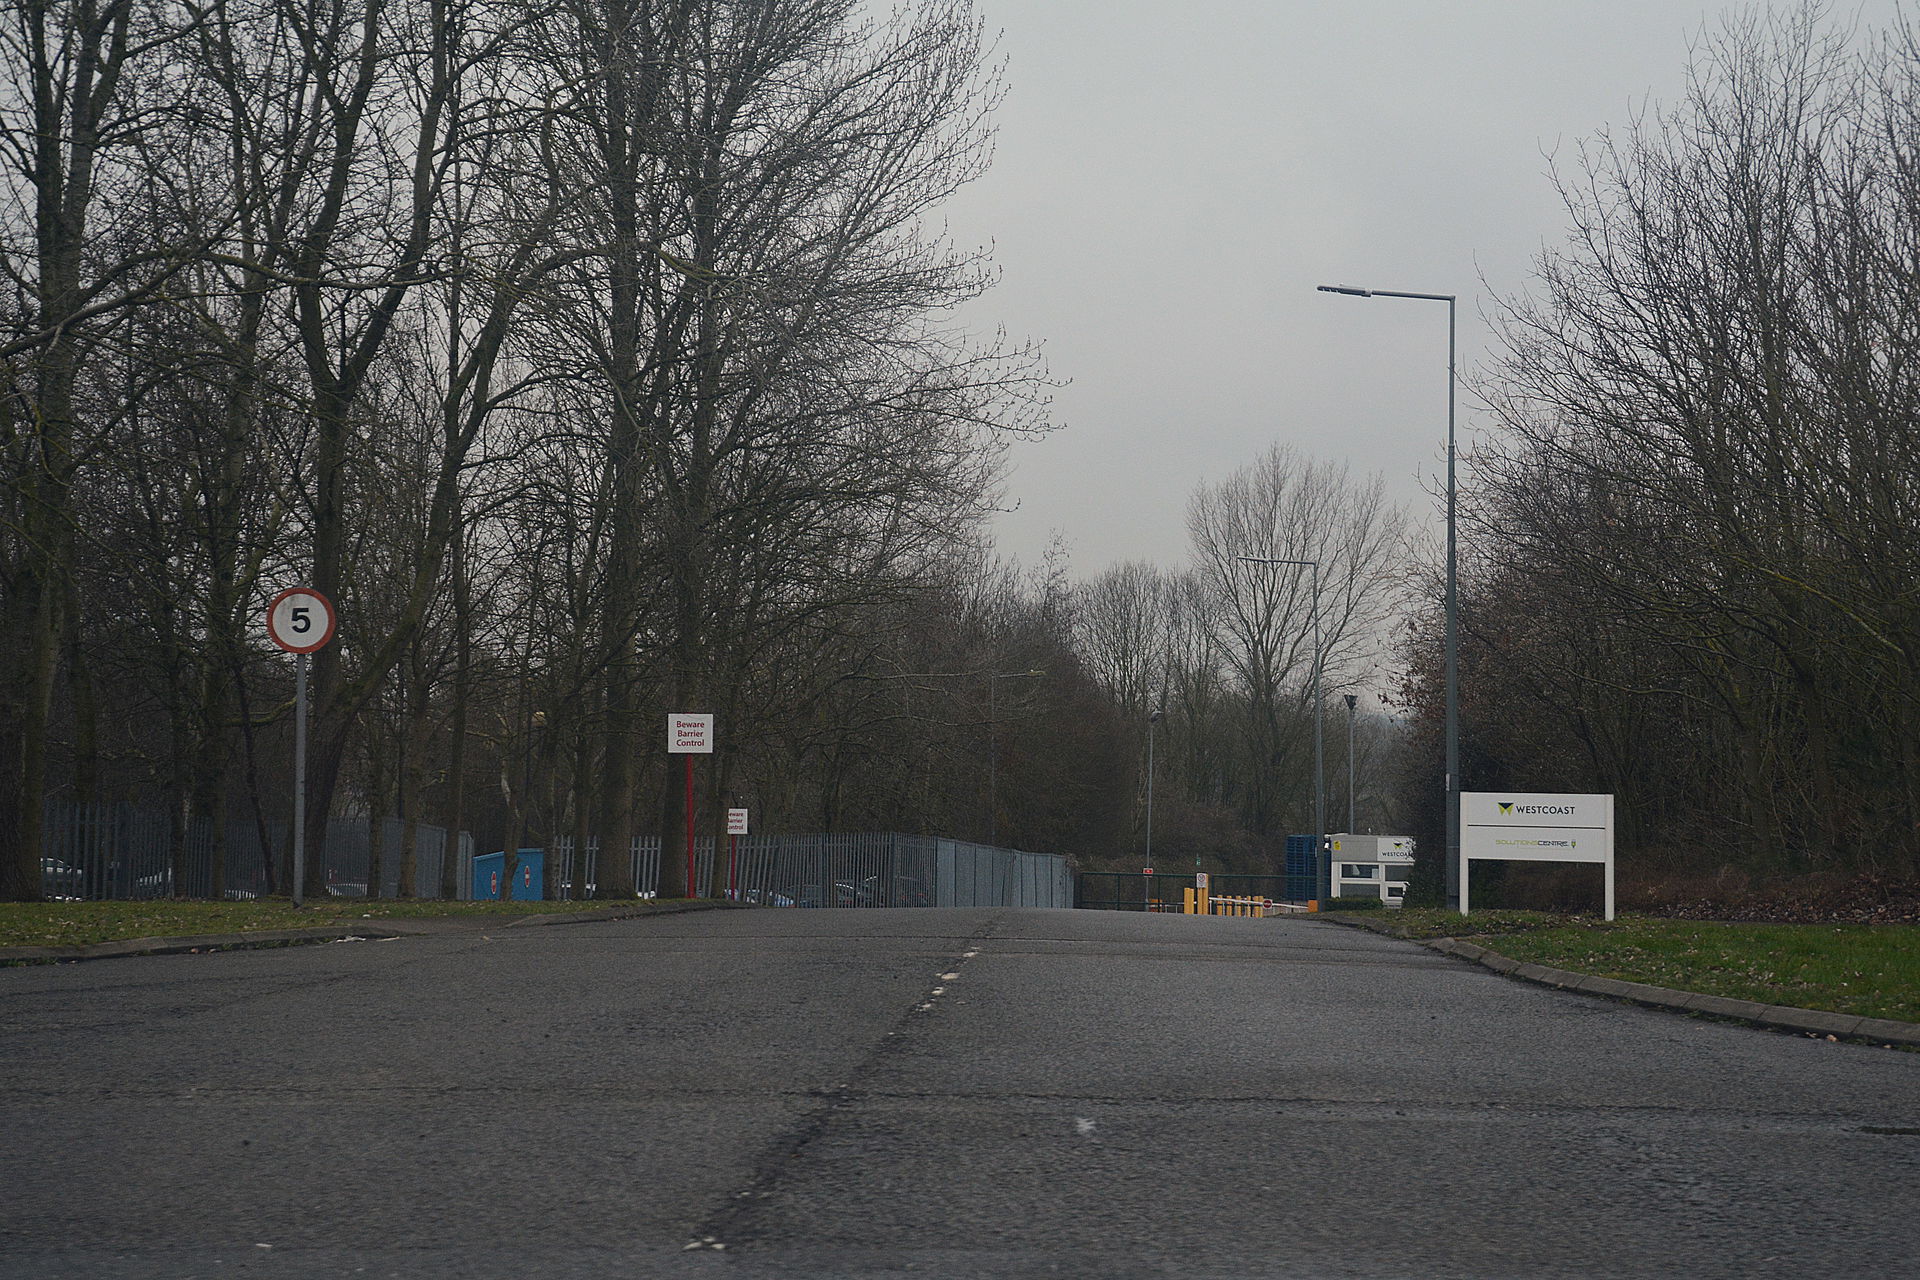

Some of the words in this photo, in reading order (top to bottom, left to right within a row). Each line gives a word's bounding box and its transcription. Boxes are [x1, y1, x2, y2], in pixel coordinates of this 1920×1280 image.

[291, 607, 311, 633] 5
[676, 720, 705, 728] Beware
[677, 729, 704, 737] Barrier
[676, 739, 705, 747] Control
[1515, 805, 1576, 815] WESTCOAST
